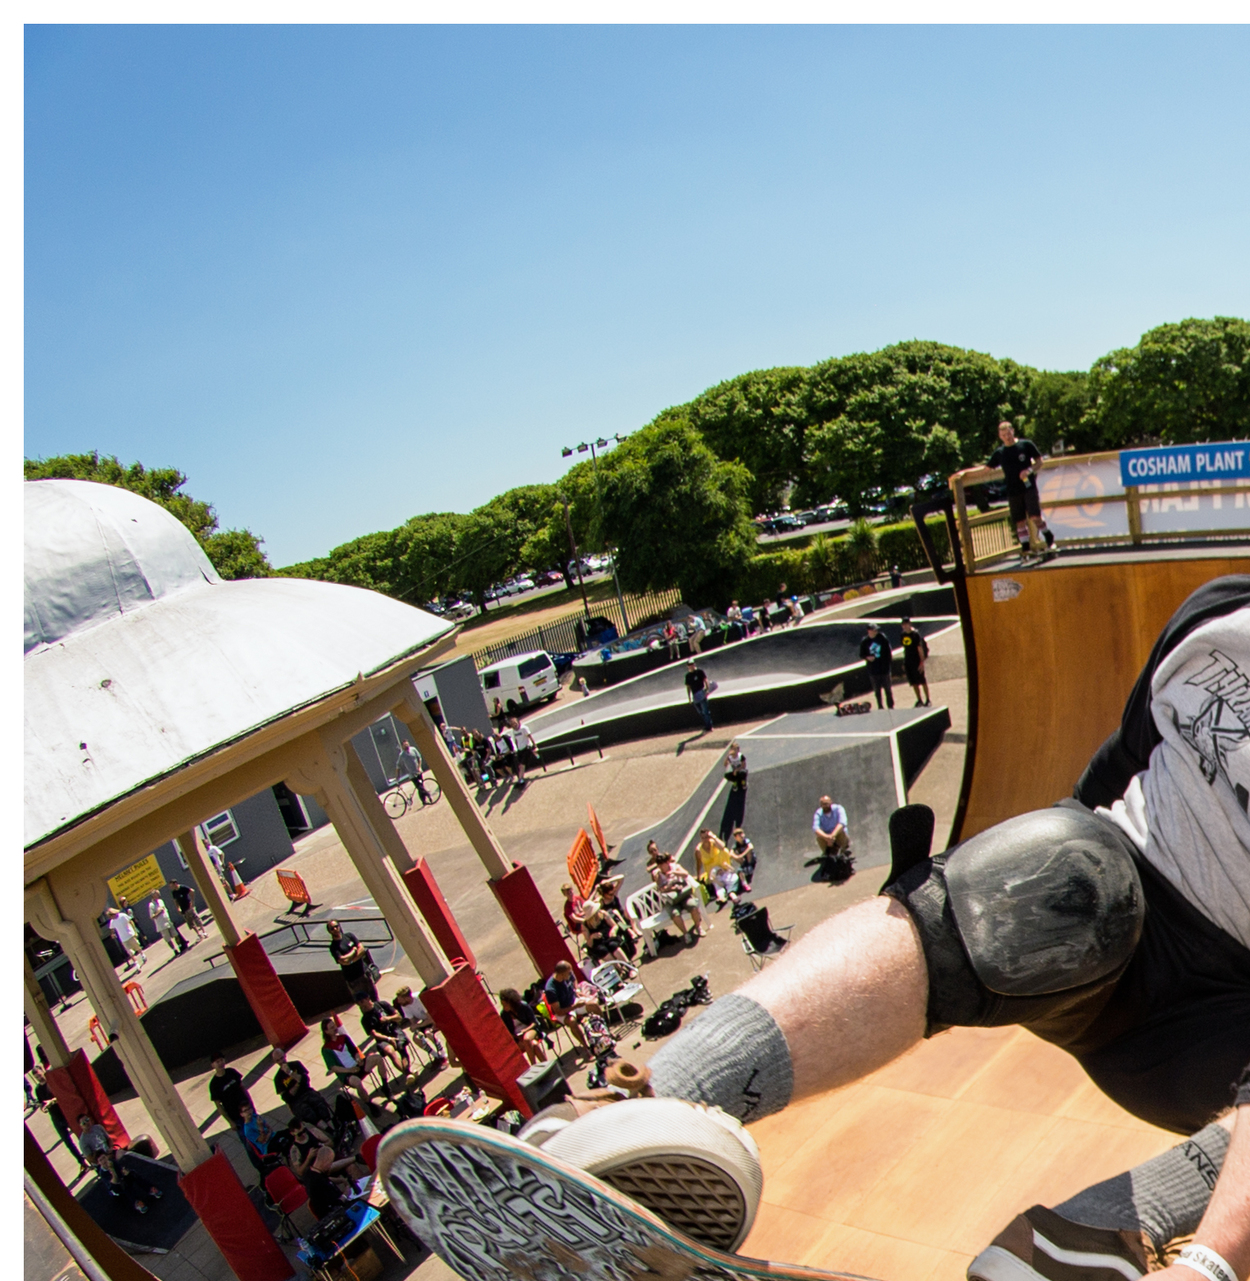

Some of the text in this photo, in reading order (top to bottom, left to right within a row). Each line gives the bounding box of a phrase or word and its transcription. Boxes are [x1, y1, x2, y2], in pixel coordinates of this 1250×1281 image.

[1128, 450, 1244, 477] COSHAM PLANT
[1183, 1143, 1218, 1191] ANS
